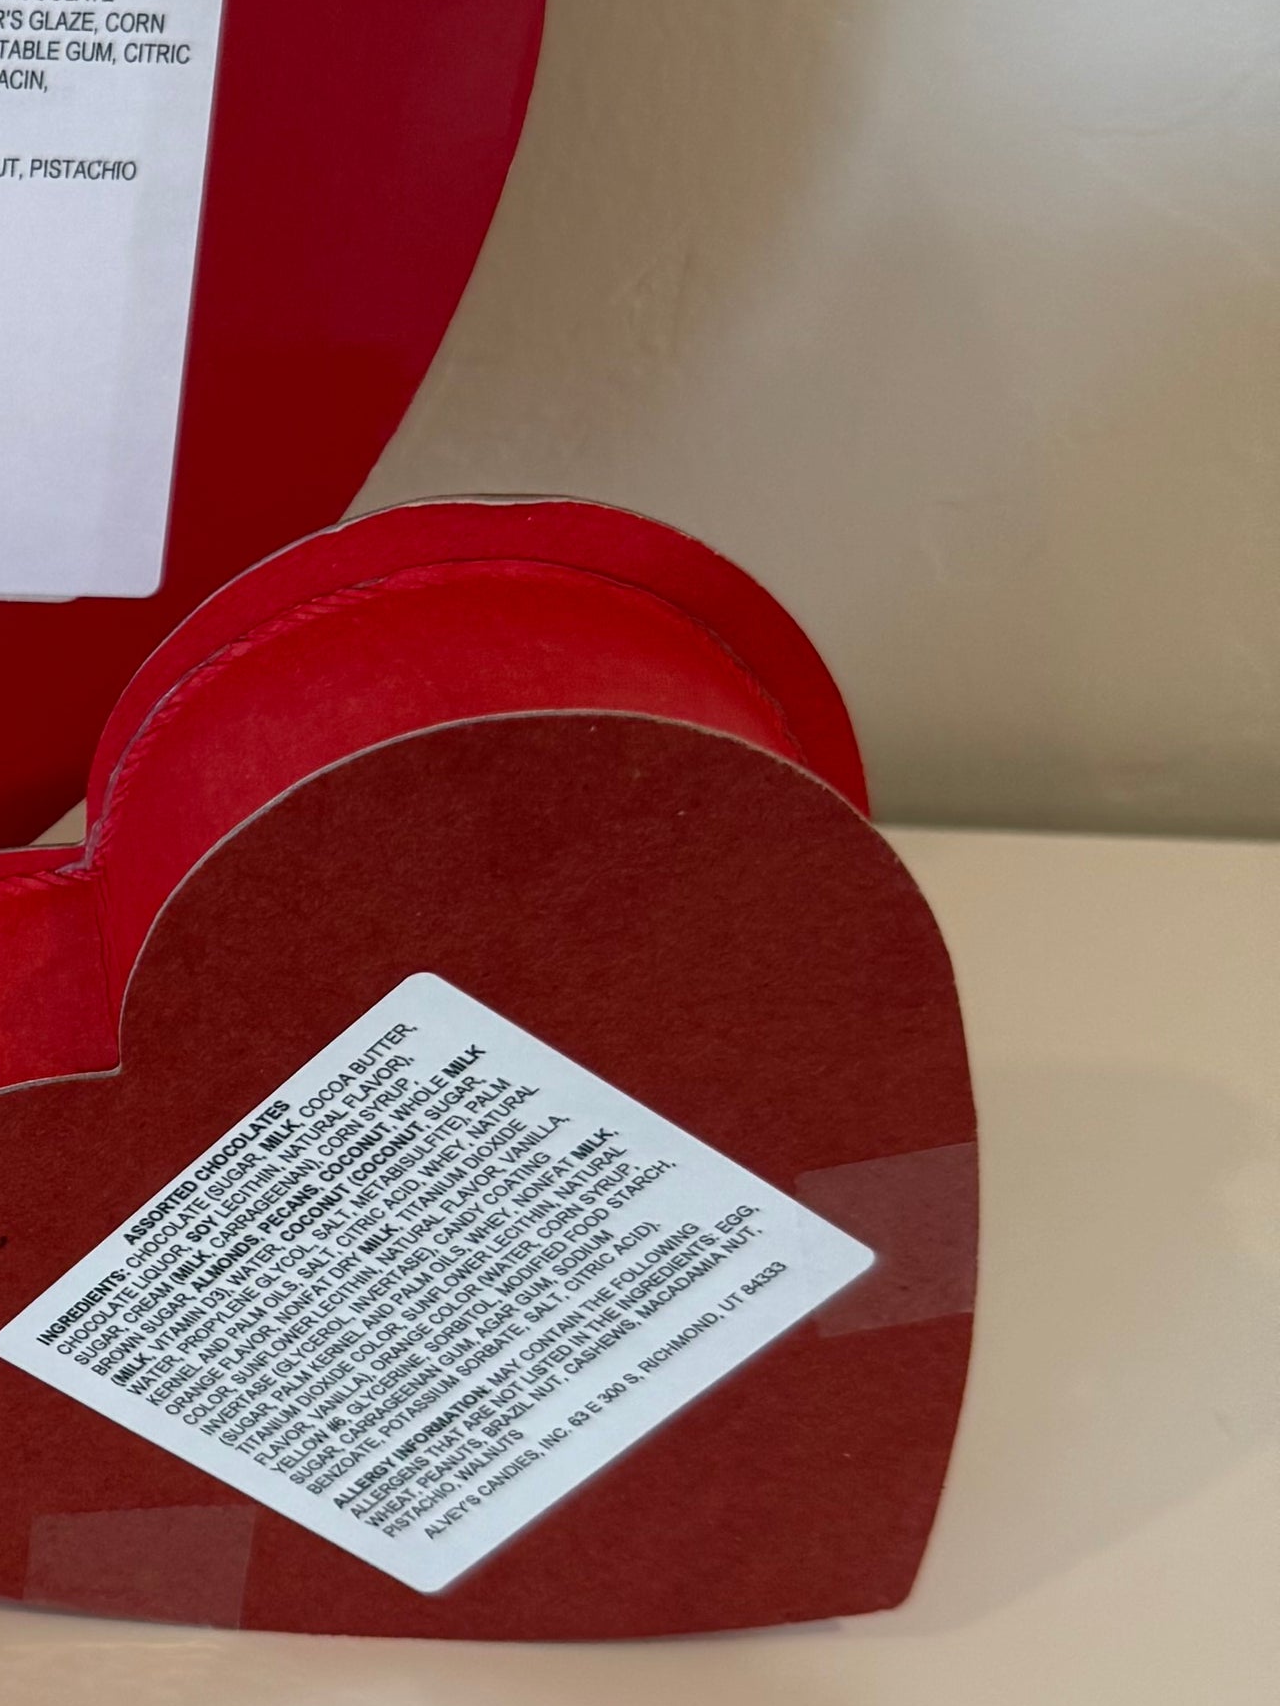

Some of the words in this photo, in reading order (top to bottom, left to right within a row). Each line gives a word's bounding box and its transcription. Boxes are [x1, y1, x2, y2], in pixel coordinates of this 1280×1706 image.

[29, 158, 137, 181] PISTACHIO
[35, 1267, 132, 1346] INGREDIENTS:
[125, 1196, 211, 1269] CHOCOLATE
[203, 1151, 268, 1202] (SUGAR,
[257, 1117, 307, 1153] MILK,
[298, 1072, 358, 1118] COCOA
[347, 1022, 418, 1075] BUTTER,
[56, 1285, 140, 1355] CHOCOLATE
[130, 1243, 194, 1291] LIQUOR,
[184, 1213, 220, 1243] SOY
[212, 1162, 287, 1219] LECITHIN,
[276, 1108, 350, 1164] NATURAL
[340, 1054, 415, 1109] FLAVOR),
[122, 1179, 199, 1246] ASSORTED
[193, 1099, 291, 1182] CHOCOLATES
[332, 1455, 397, 1510] ALLERGY
[391, 1384, 493, 1461] INFORMATION:
[485, 1357, 522, 1387] MAY
[518, 1309, 587, 1361] CONTAIN
[577, 1286, 617, 1312] THE
[609, 1222, 700, 1291] FOLLOWING
[349, 1455, 431, 1520] ALLERGENS
[423, 1425, 465, 1457] THAT
[462, 1403, 497, 1432] ARE
[488, 1379, 524, 1408] NOT
[519, 1343, 574, 1385] LISTED
[567, 1329, 592, 1347] IN
[582, 1306, 622, 1332] THE
[614, 1232, 720, 1311] INGREDIENTS:
[713, 1204, 760, 1234] EGG,
[477, 1448, 546, 1496] CANDIES,
[538, 1427, 572, 1450] INC.
[567, 1410, 591, 1427] 63
[584, 1400, 603, 1414] E
[596, 1381, 628, 1404] 300
[622, 1372, 645, 1384] S,
[637, 1311, 725, 1373] RICHMOND,
[717, 1291, 744, 1312] UT
[739, 1260, 788, 1295] 84333
